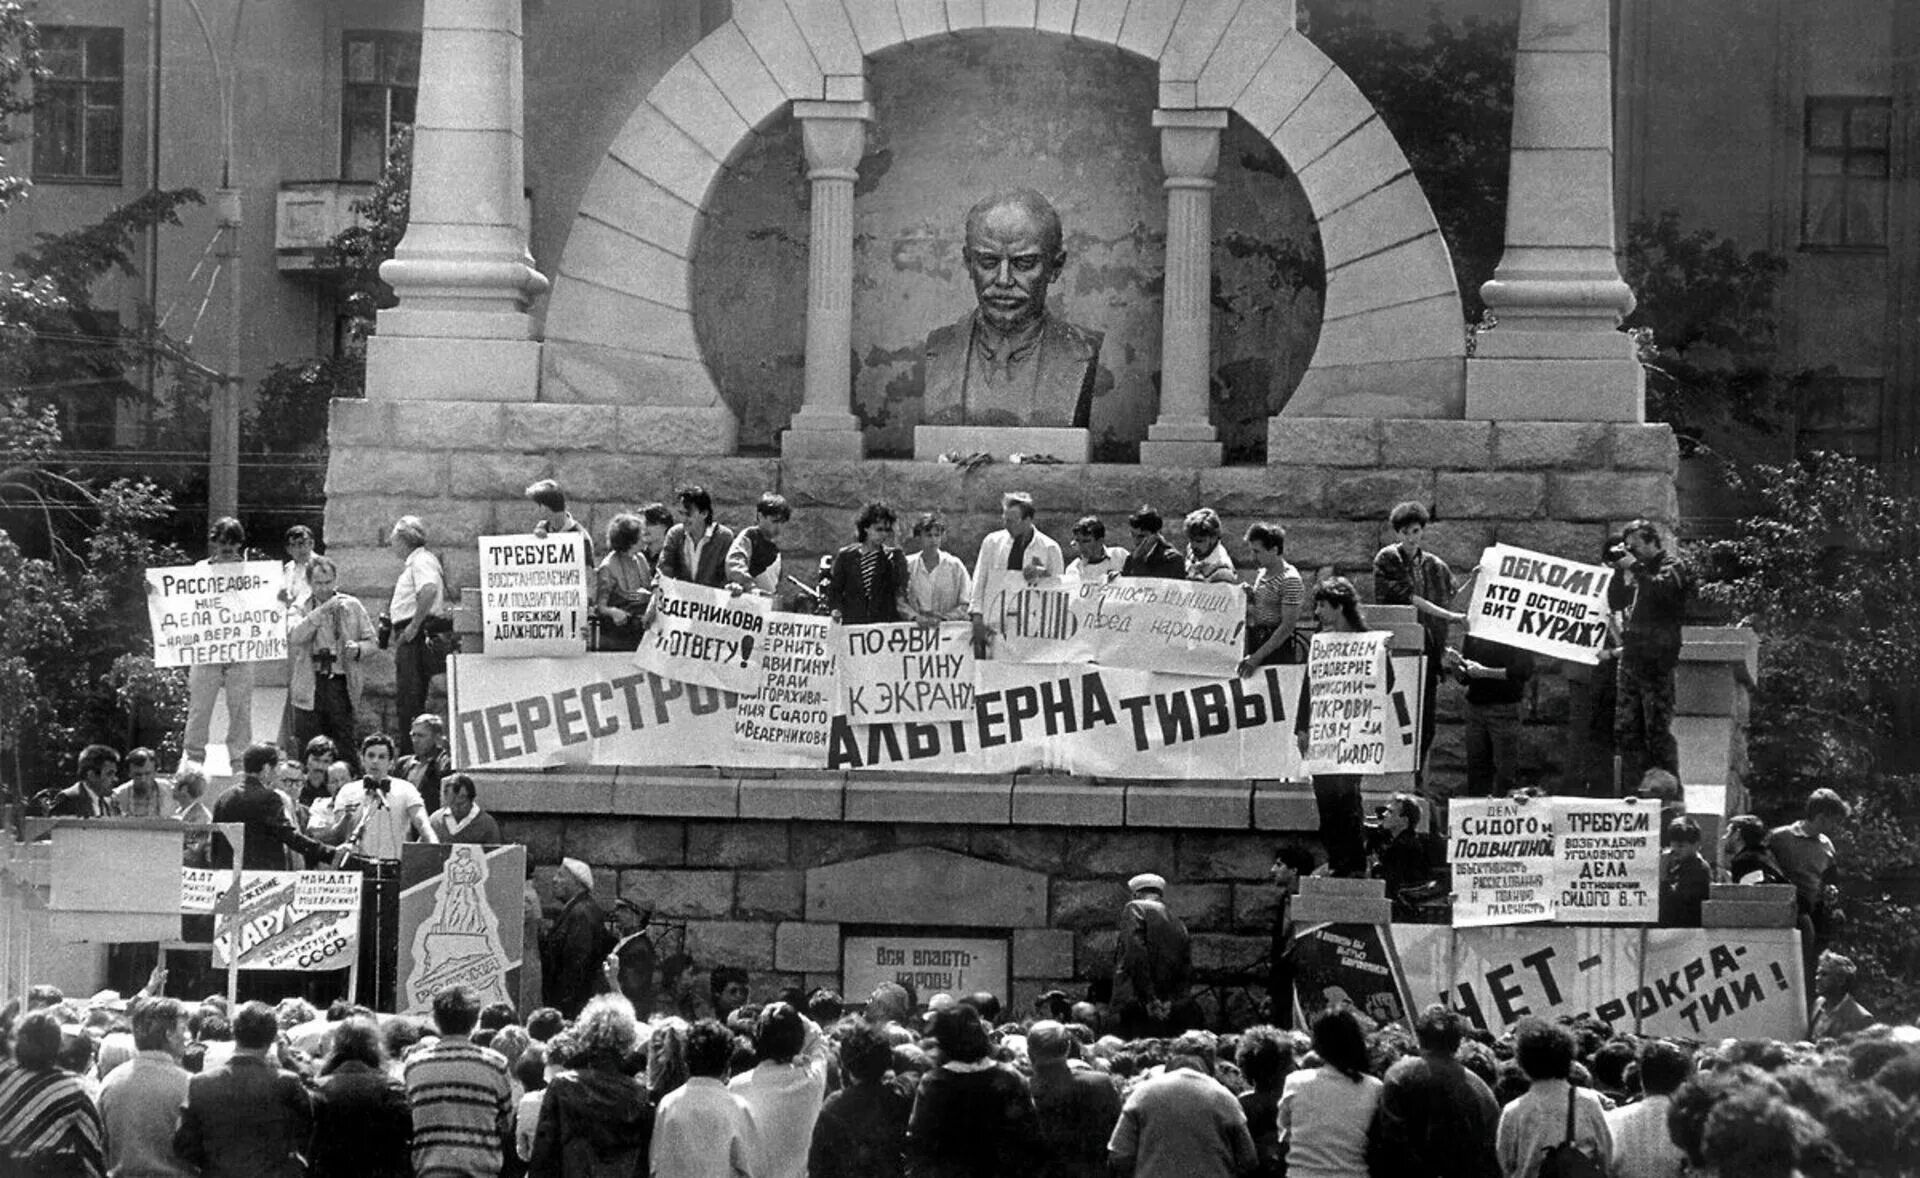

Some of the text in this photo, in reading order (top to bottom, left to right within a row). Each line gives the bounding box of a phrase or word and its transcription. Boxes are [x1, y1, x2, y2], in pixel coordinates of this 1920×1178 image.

[489, 543, 575, 566] ТРЕБУЕМ
[195, 597, 222, 609] НИЕ
[1486, 583, 1600, 620] КТО ОСТАНО-
[161, 610, 212, 631] ДЕЛА
[512, 610, 560, 622] ПРЕЖНЕЙ
[1482, 602, 1606, 648] ВИТ КУРАЖ?
[204, 626, 241, 641] ВЕРА
[251, 625, 262, 638] В
[767, 622, 828, 640] ЕКРАТИТЕ
[849, 627, 952, 656] ПОДВИ-
[903, 654, 964, 680] ГИНУ
[767, 673, 808, 688] РАДИ
[849, 681, 975, 716] К ЭКРАНУ!
[738, 704, 766, 718] НИЯ
[1567, 812, 1649, 833] ТРЕБУЕМ
[1565, 837, 1647, 849] ВОЗБУЖДЕНИЯ
[1564, 850, 1635, 861] УГОЛОВНОГО
[300, 874, 354, 886] МАНДАТ
[1579, 862, 1628, 880] ДЕЛА
[1580, 882, 1640, 890] ОТНОШЕНИИ
[1561, 891, 1610, 907] СИДОГО
[298, 937, 348, 968] СССР
[1438, 946, 1564, 1030] НЕТ
[1680, 972, 1766, 1033] ТИИ
